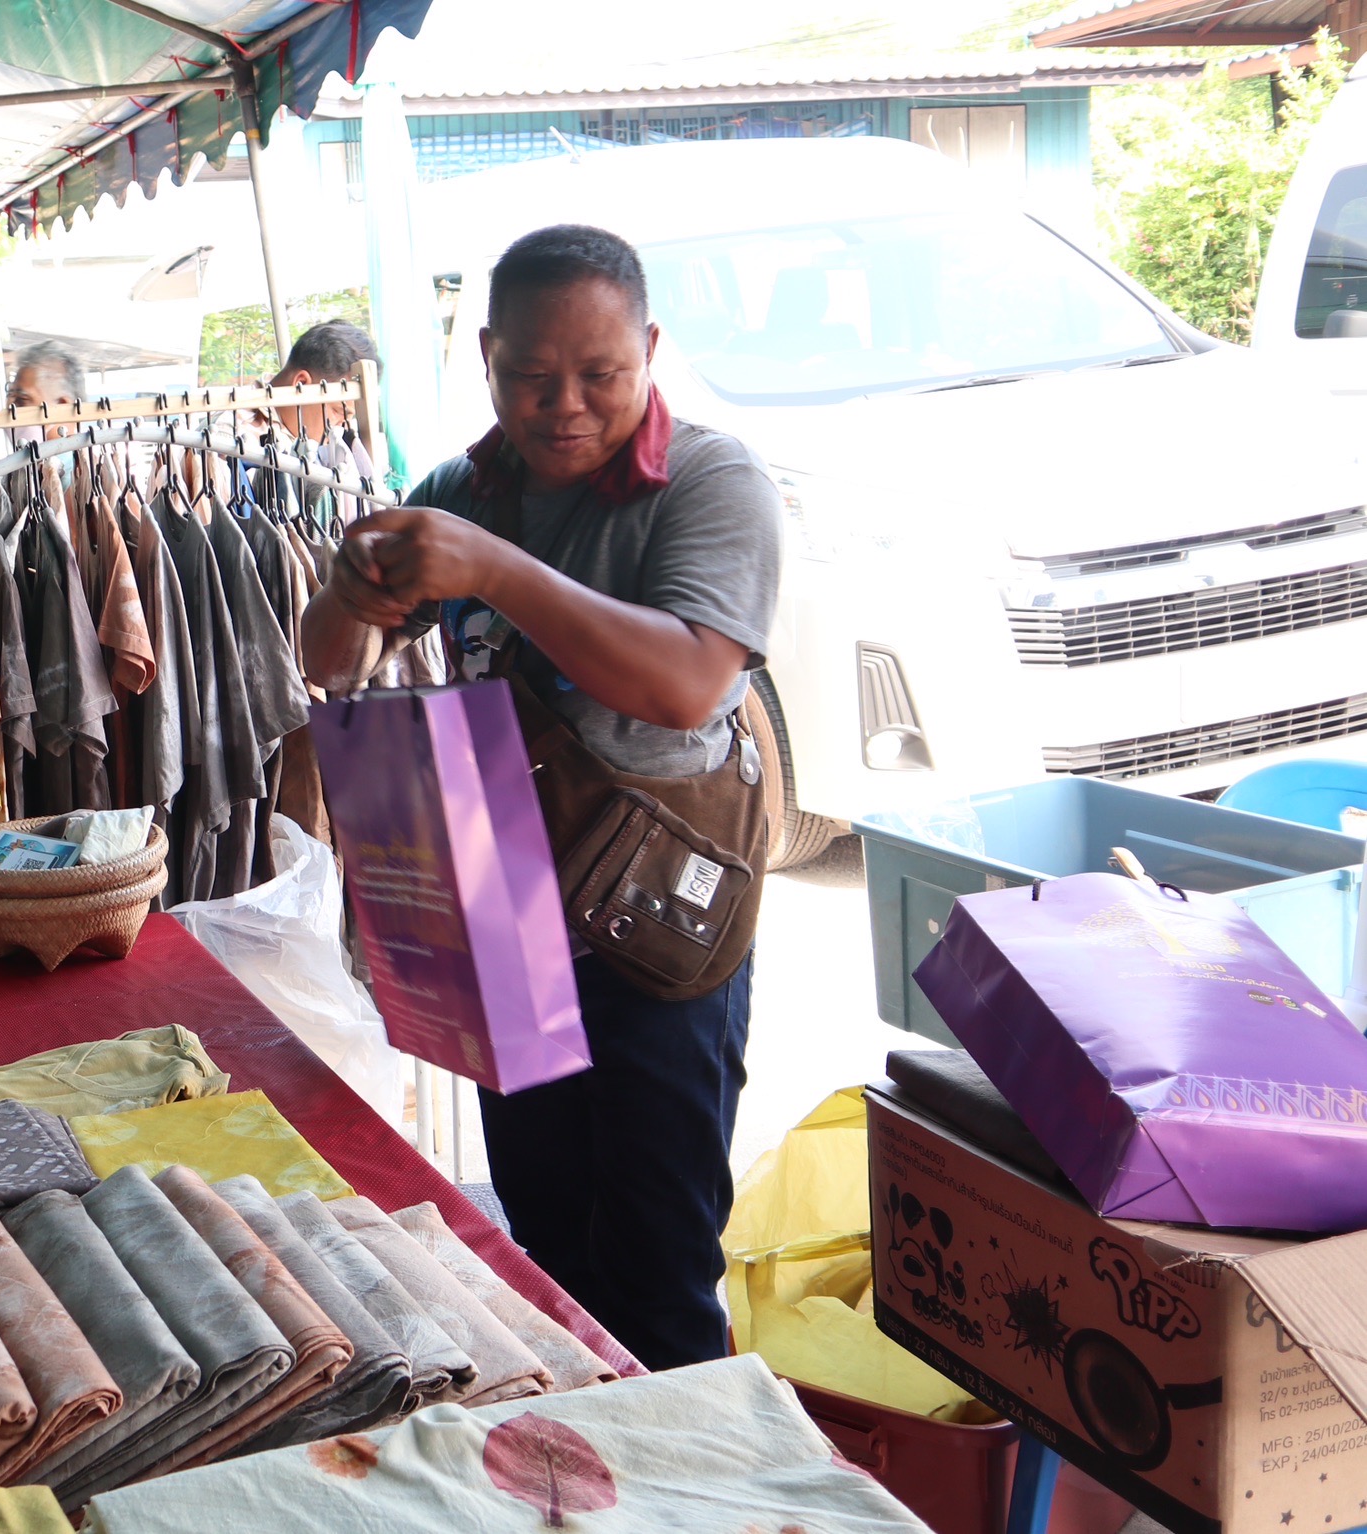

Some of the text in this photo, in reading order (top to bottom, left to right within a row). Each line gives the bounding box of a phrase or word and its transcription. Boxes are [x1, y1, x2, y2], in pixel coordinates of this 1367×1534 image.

[909, 1138, 946, 1168] PP04003
[915, 1338, 927, 1356] 22
[965, 1372, 976, 1390] 12
[1010, 1402, 1024, 1422] 24
[1028, 1415, 1058, 1444] กล่อง
[1260, 1387, 1289, 1403] 32/9
[1259, 1406, 1276, 1422] โทร
[1262, 1435, 1294, 1455] MFG
[1262, 1455, 1291, 1473] EXP
